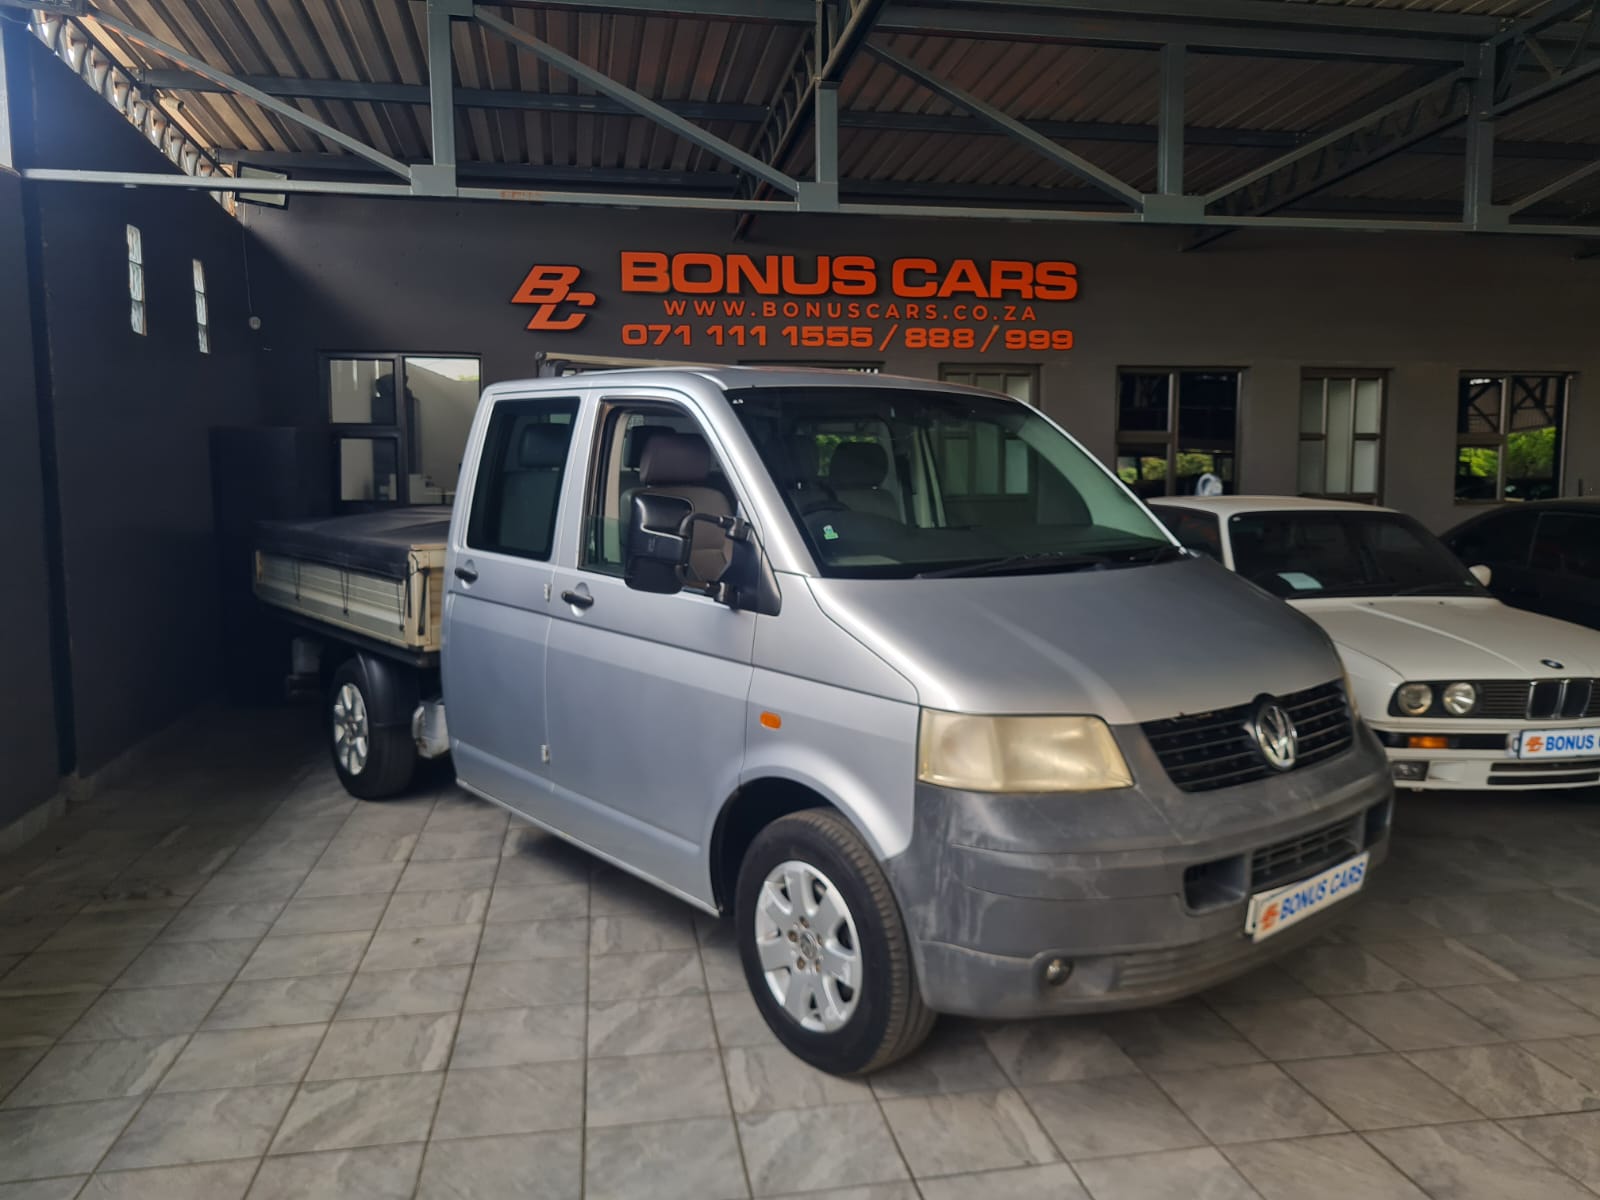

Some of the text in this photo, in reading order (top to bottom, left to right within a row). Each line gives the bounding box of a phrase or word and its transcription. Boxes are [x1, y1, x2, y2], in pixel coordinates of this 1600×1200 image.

[620, 250, 1078, 301] BONUS CARS
[663, 299, 1037, 322] WWW.BONUSCARS.CO.ZA
[621, 323, 691, 347] 071
[706, 323, 768, 348] 111
[1545, 735, 1594, 751] BONUS
